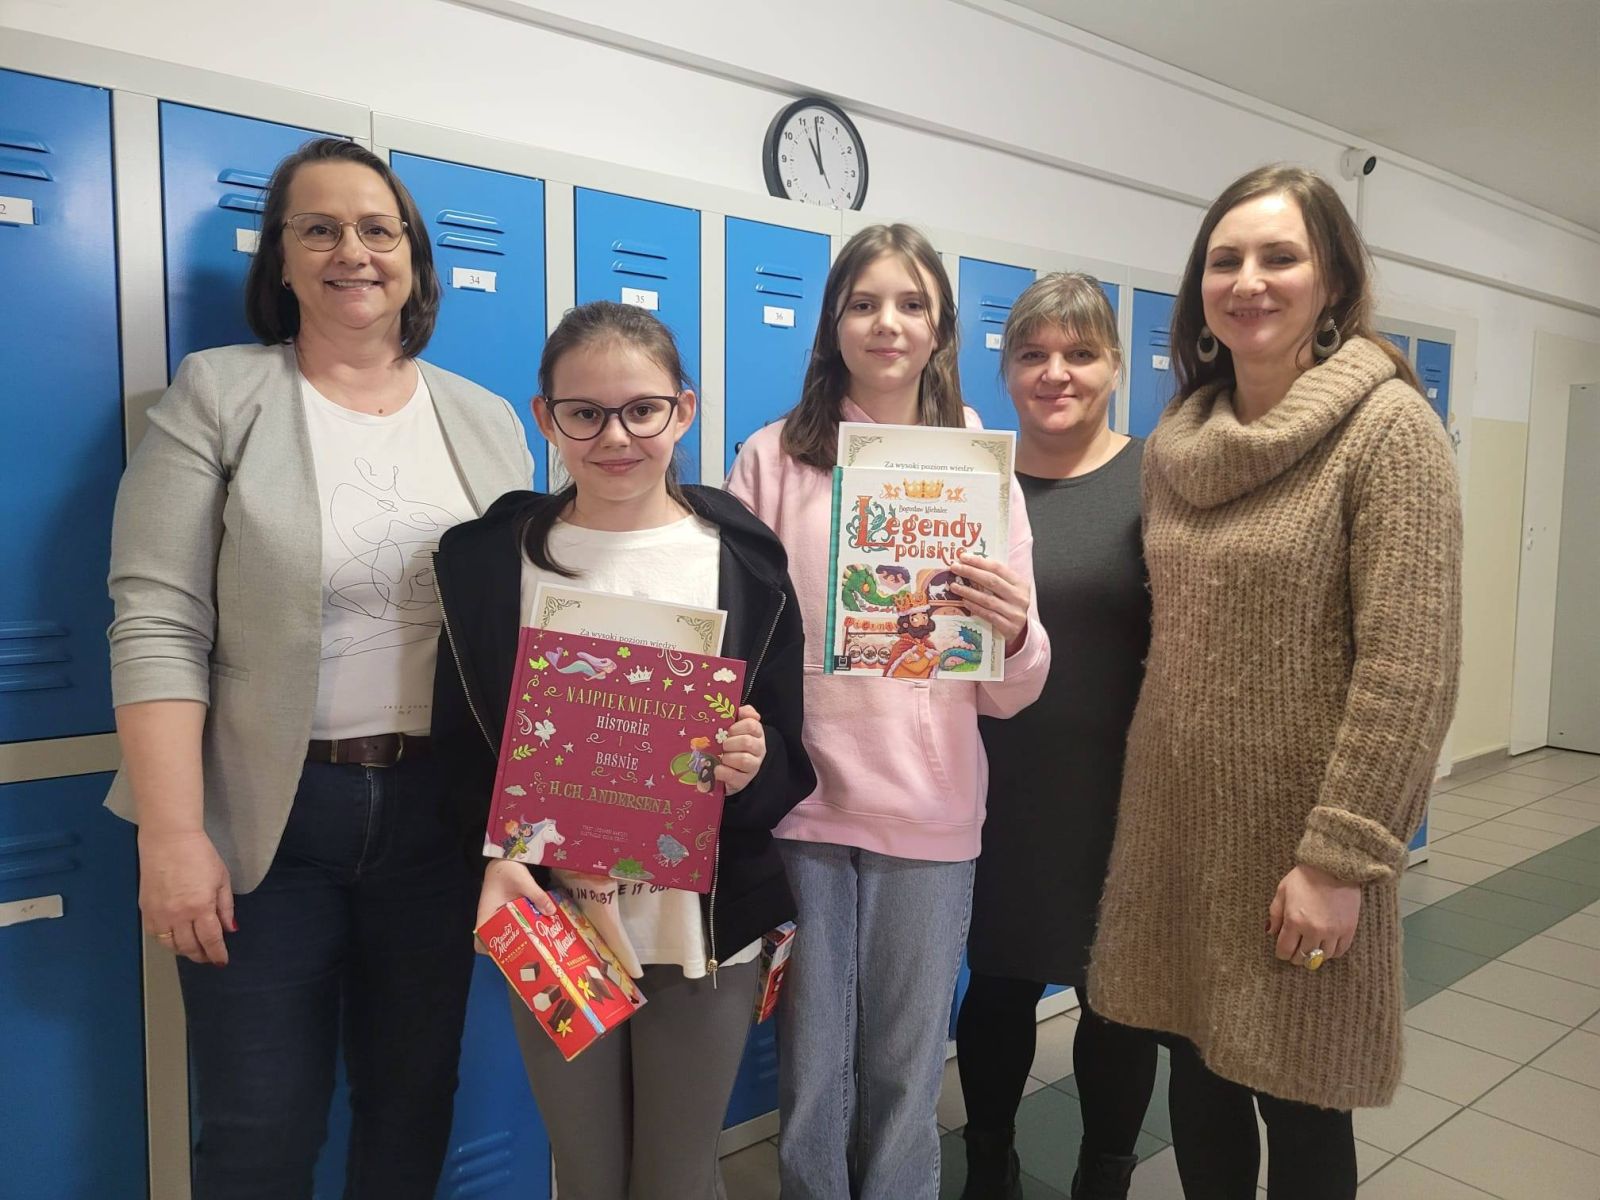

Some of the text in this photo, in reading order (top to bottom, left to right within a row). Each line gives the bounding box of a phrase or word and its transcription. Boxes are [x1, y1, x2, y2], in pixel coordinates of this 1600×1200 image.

[798, 117, 806, 127] 11
[815, 116, 825, 125] 12
[784, 132, 793, 140] 10
[834, 127, 839, 135] 1
[846, 146, 852, 154] 2
[850, 170, 856, 178] 3
[786, 180, 792, 188] 8
[846, 192, 851, 200] 4
[469, 275, 480, 285] 34
[635, 294, 645, 304] 35
[896, 462, 920, 470] wysoki
[949, 464, 975, 473] wiedzy
[855, 495, 982, 547] Legendy
[895, 541, 968, 566] polskie
[580, 628, 678, 650] Za wysoki poziom wiedzy
[587, 786, 673, 815] ANDERSENA
[576, 888, 588, 900] IN
[632, 883, 645, 895] IT
[649, 884, 670, 893] OU
